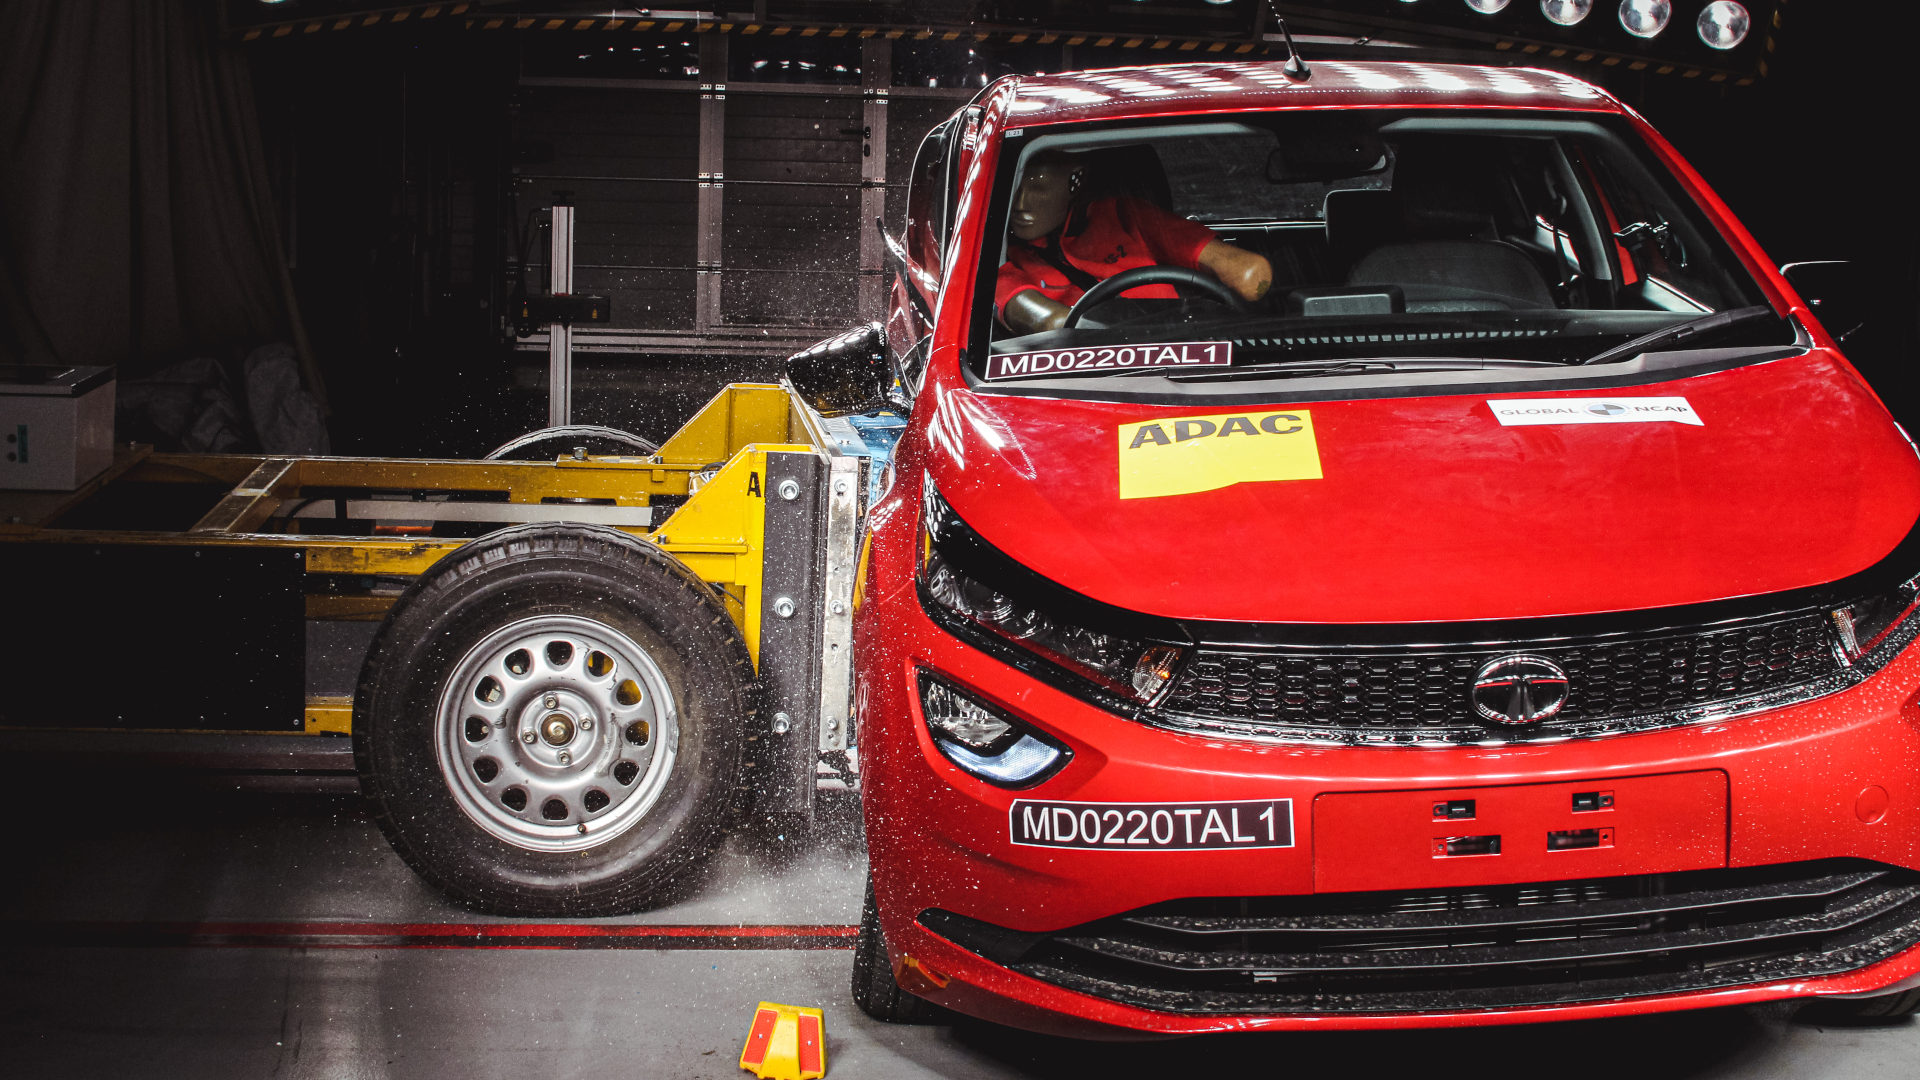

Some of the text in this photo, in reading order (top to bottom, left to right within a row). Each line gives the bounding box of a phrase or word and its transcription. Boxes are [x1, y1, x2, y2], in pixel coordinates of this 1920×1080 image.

[1000, 344, 1216, 376] MD0220TAL1
[1500, 407, 1580, 416] GLOBAL
[1128, 414, 1304, 450] ADAC
[747, 471, 762, 498] A
[1023, 806, 1275, 844] MD0220TAL1
